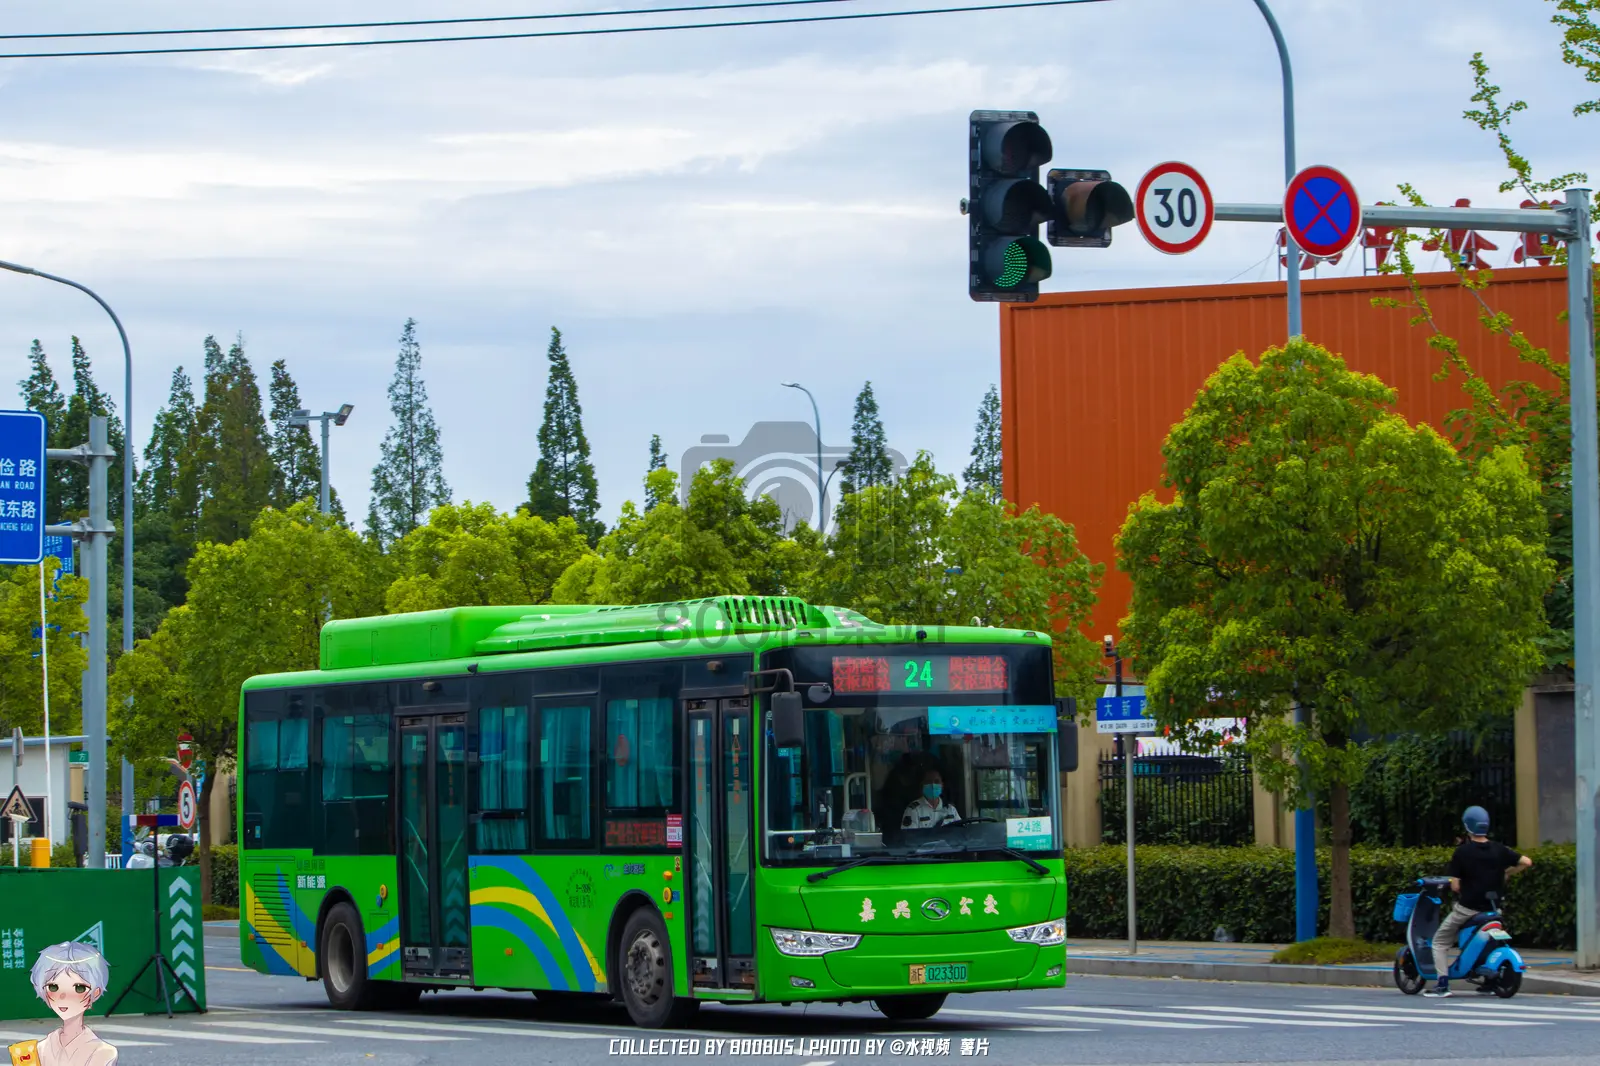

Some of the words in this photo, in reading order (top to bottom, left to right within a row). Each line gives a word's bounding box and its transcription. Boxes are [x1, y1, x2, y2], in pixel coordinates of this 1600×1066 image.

[1154, 188, 1197, 228] 30
[15, 481, 35, 490] ROAD
[21, 523, 33, 531] ROAD
[904, 660, 933, 688] 24
[183, 793, 190, 819] 5
[297, 875, 326, 888] 新能源
